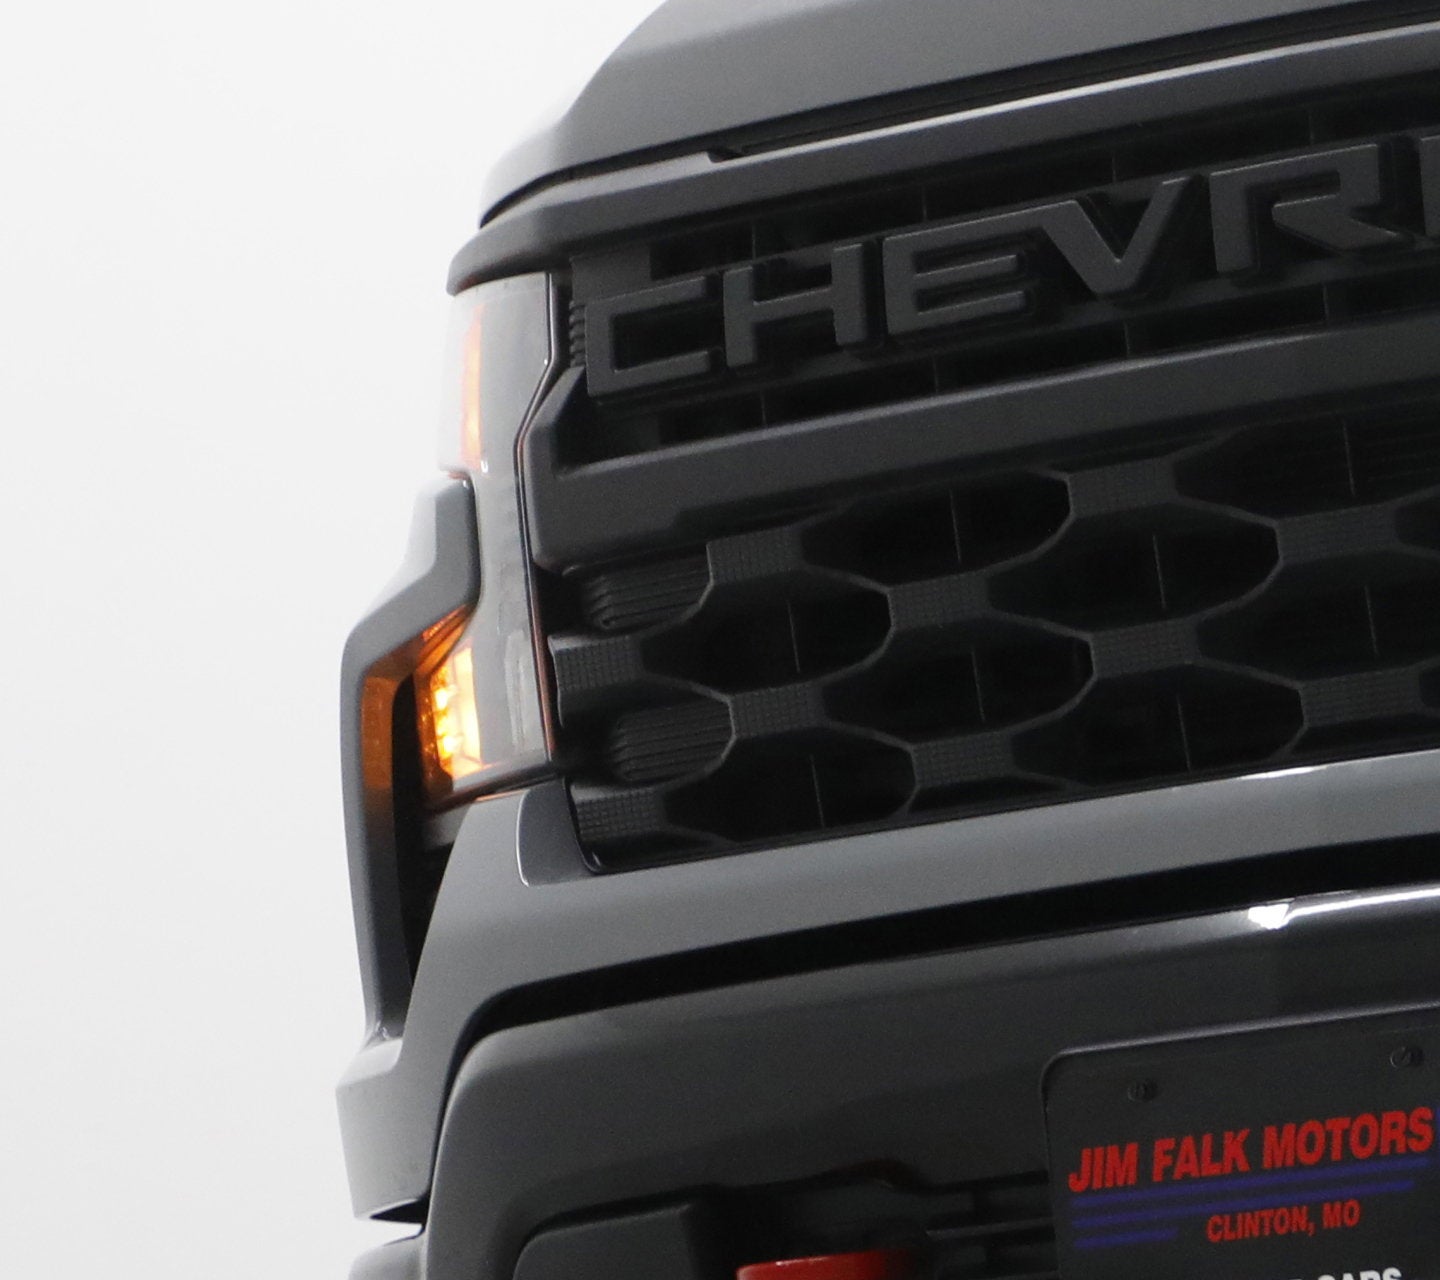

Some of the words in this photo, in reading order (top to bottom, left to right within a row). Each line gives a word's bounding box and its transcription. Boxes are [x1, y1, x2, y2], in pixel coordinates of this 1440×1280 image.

[1068, 1141, 1139, 1193] JIM
[1152, 1128, 1251, 1183] FALK
[1262, 1106, 1435, 1169] MOTORS
[1206, 1205, 1315, 1244] CLINTON,
[1322, 1198, 1362, 1229] MO
